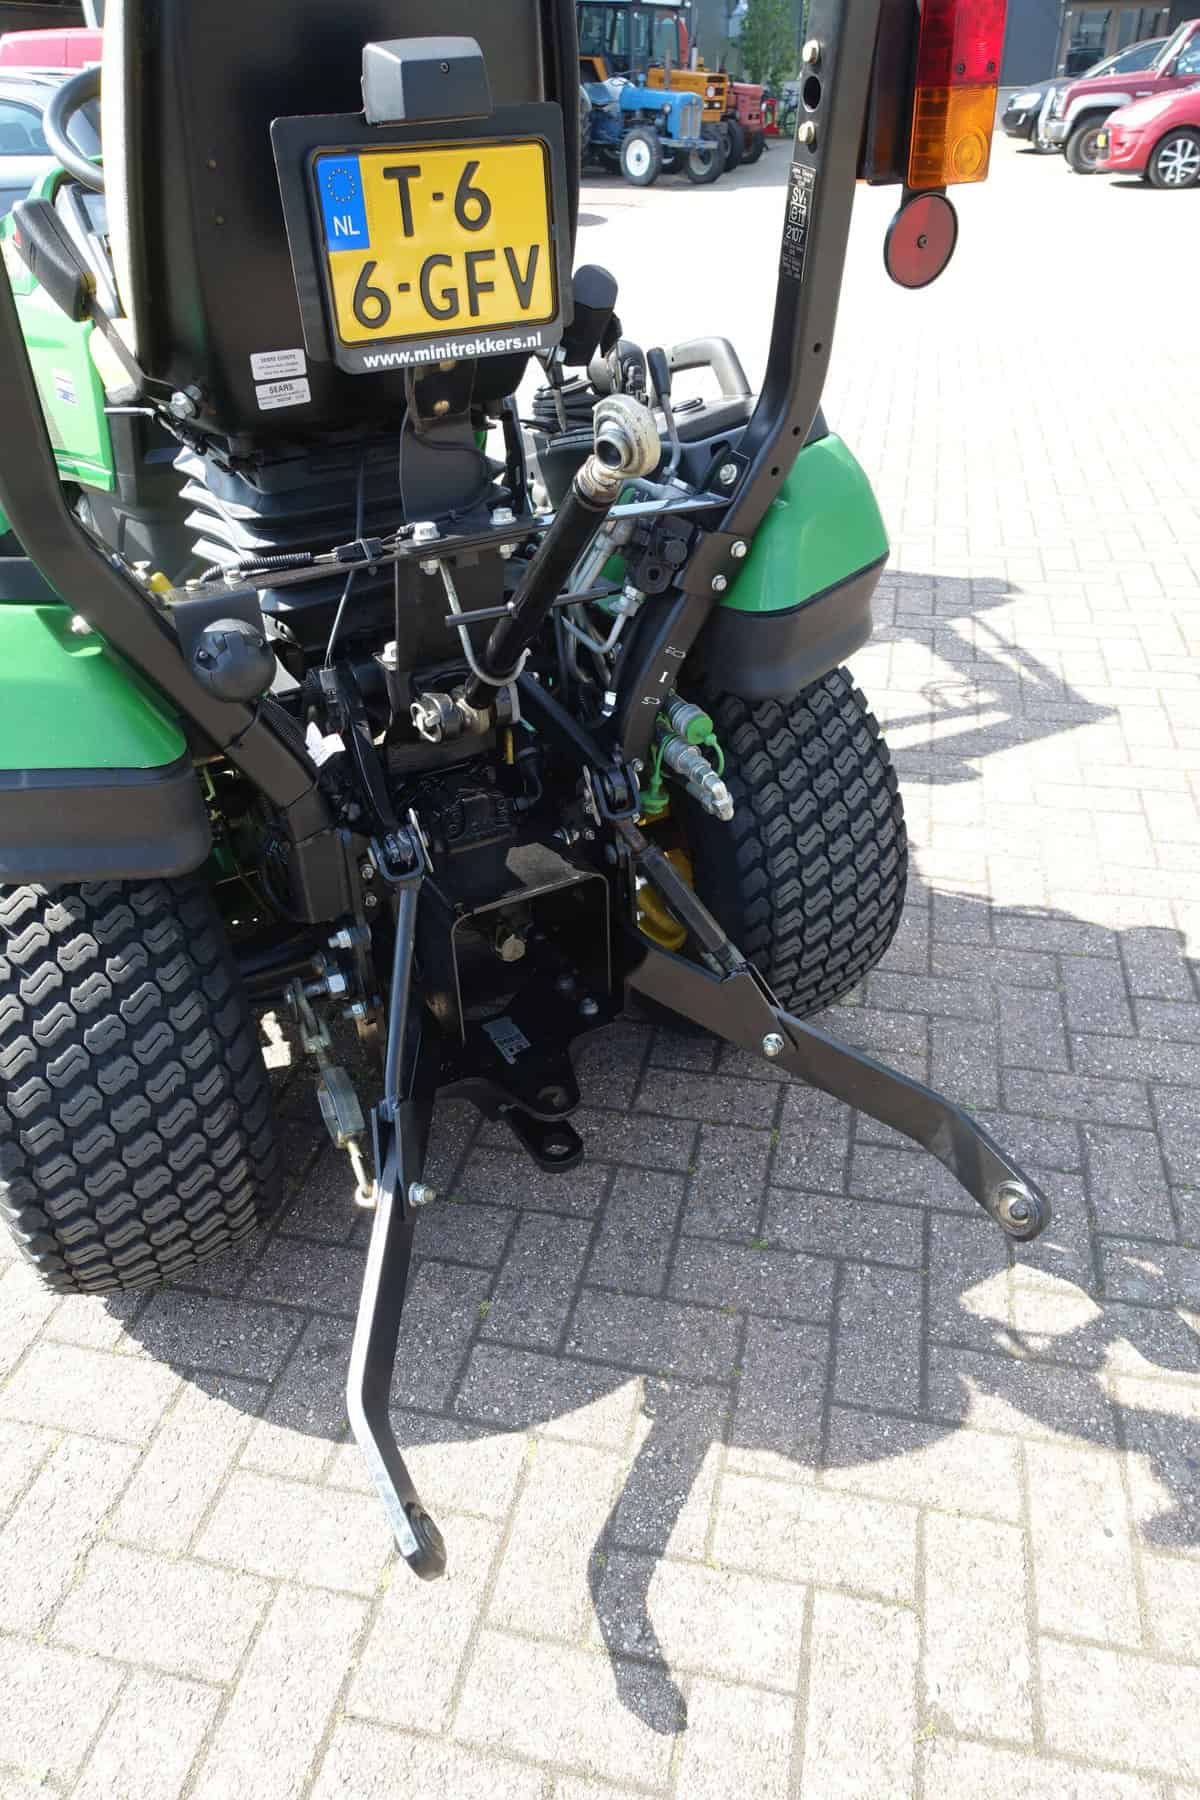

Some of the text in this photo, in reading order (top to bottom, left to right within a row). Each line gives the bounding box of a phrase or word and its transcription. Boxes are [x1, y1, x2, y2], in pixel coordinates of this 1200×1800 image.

[333, 215, 361, 237] NL
[383, 161, 491, 237] T-6
[353, 245, 540, 329] 6-GFV
[363, 332, 542, 368] www.minitrekkers.nl
